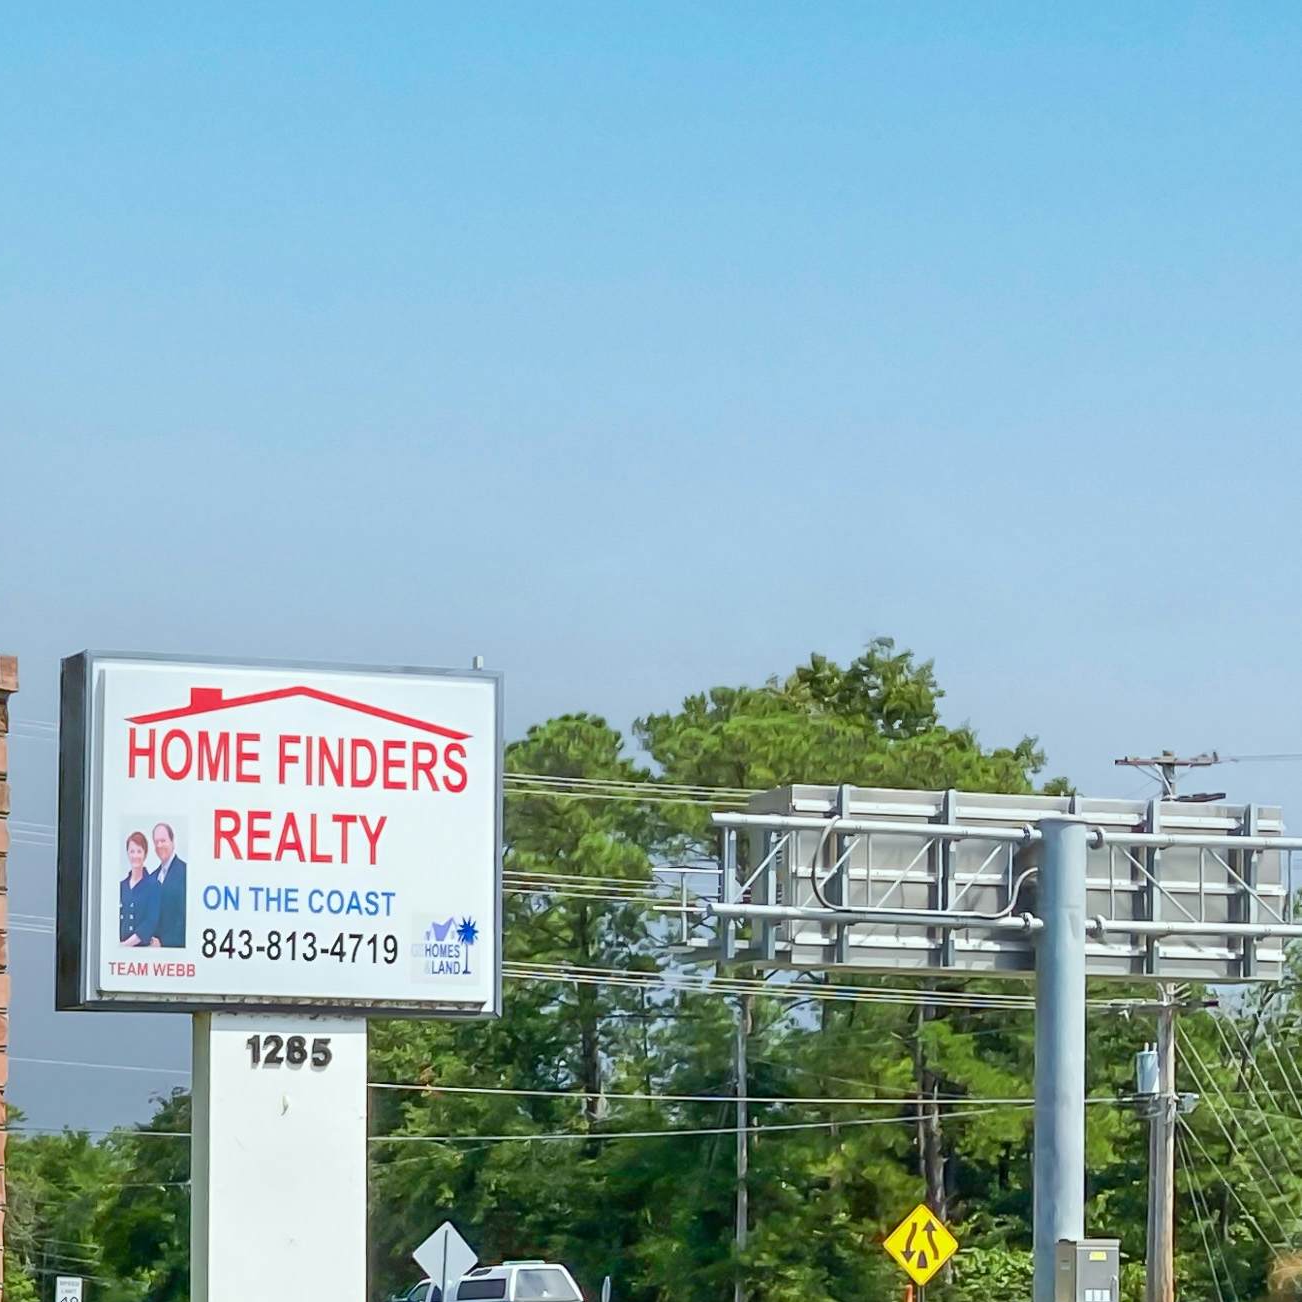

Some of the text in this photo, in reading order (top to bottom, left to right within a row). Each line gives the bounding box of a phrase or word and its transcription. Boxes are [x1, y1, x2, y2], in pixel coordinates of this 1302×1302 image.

[128, 727, 469, 793] HOME FINDERS
[213, 809, 388, 865] REALTY
[202, 885, 396, 916] ON THE COAST
[201, 928, 398, 965] 843-813-4719
[424, 944, 461, 958] HOMES
[108, 961, 196, 978] TEAM WEBB
[431, 961, 461, 975] LAND
[246, 1034, 333, 1068] 1285
